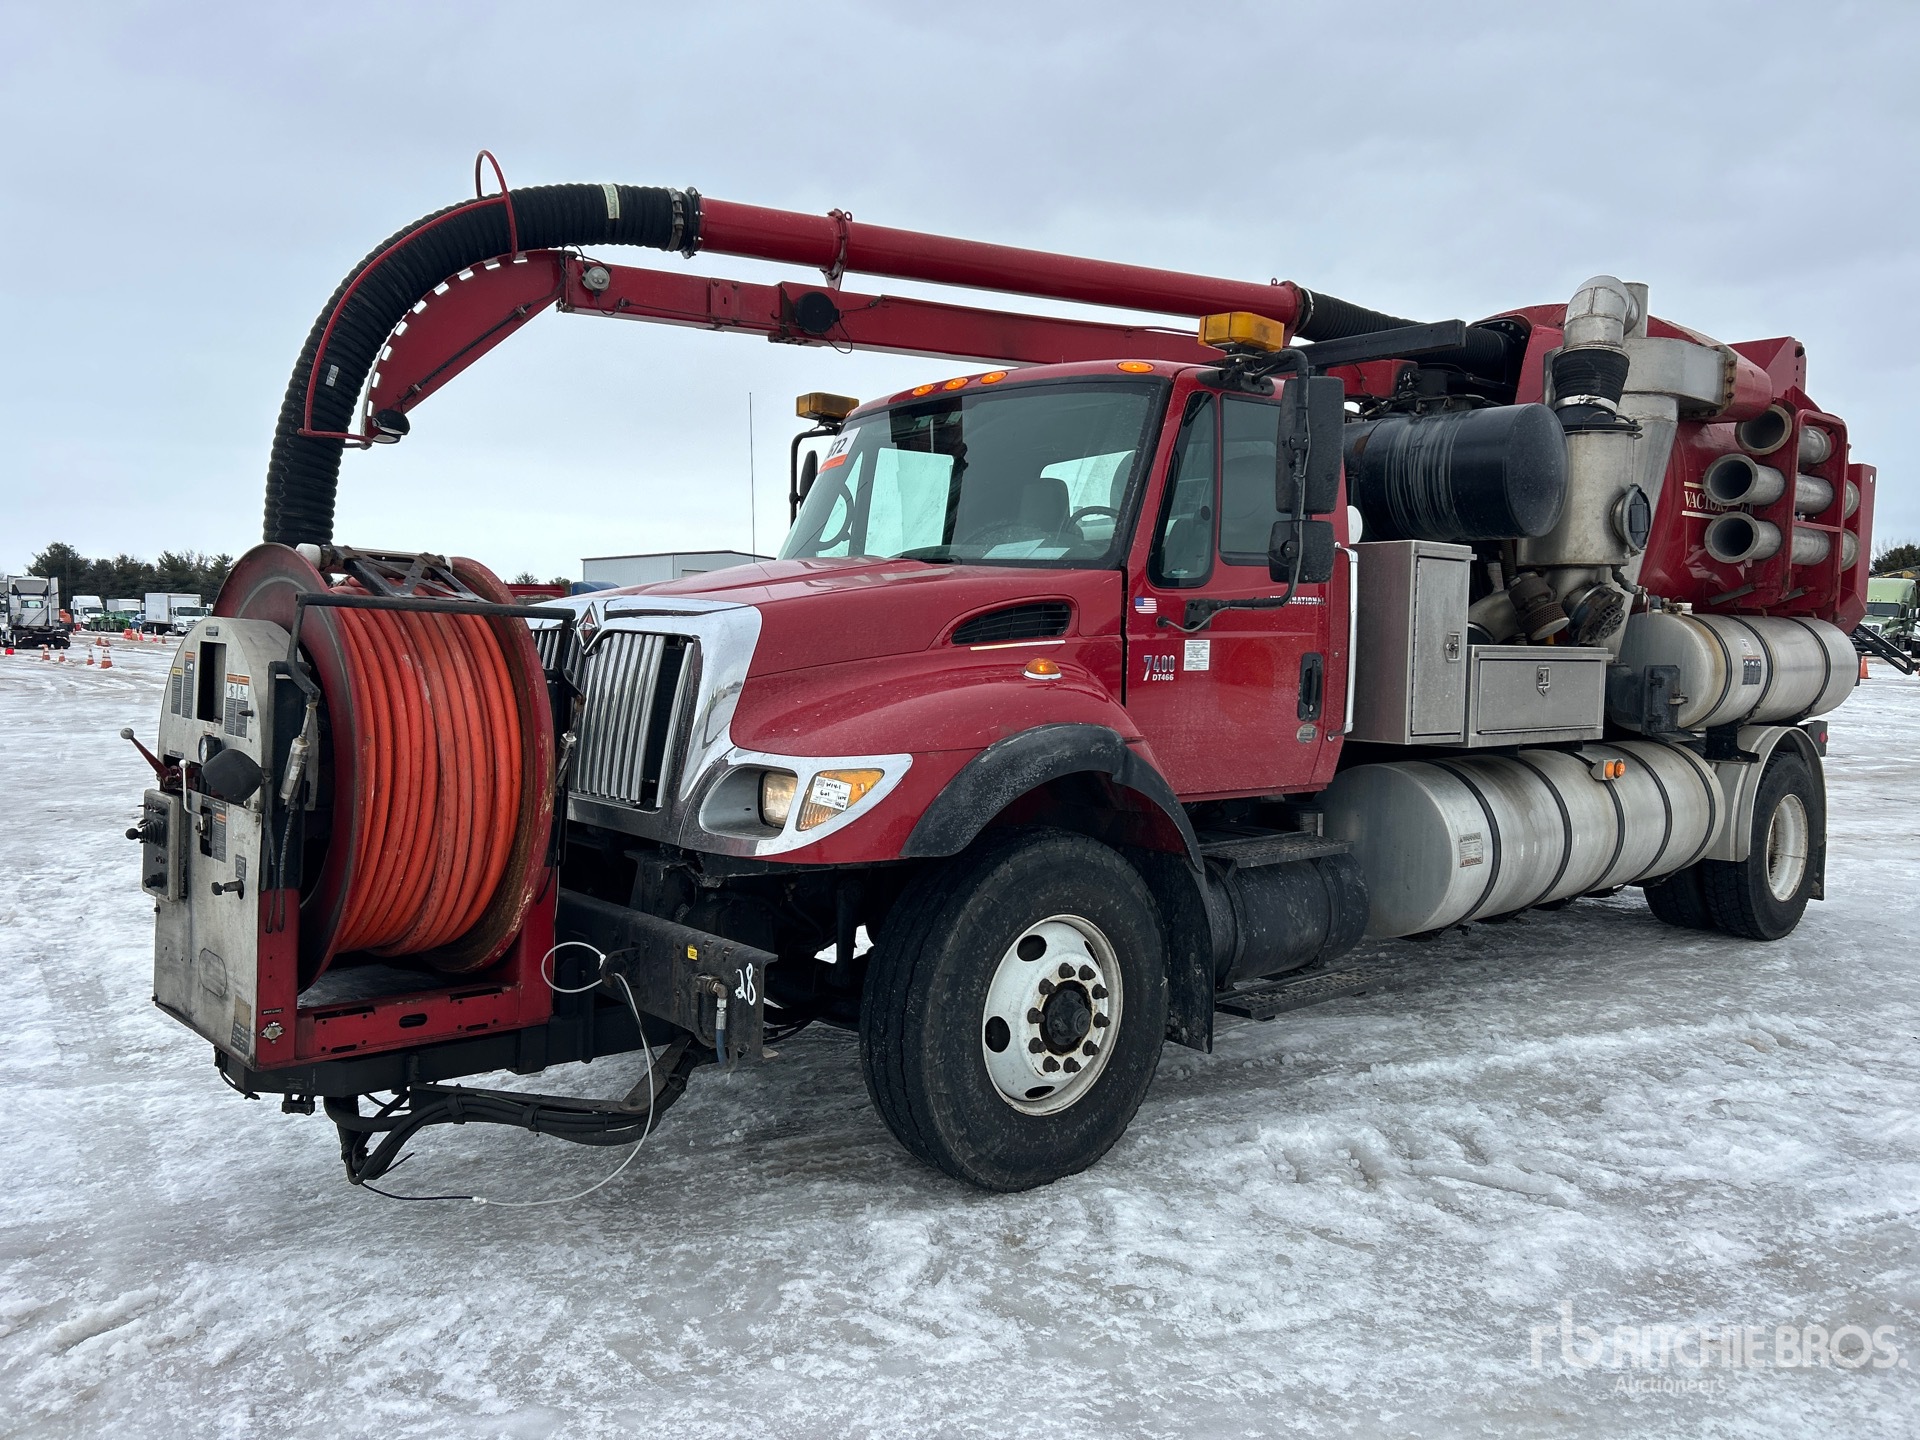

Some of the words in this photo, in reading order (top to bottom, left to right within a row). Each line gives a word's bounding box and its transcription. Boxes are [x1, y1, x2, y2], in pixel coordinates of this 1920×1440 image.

[1270, 595, 1326, 605] NATIONAL
[1143, 655, 1175, 681] 7400
[735, 962, 756, 1006] 28
